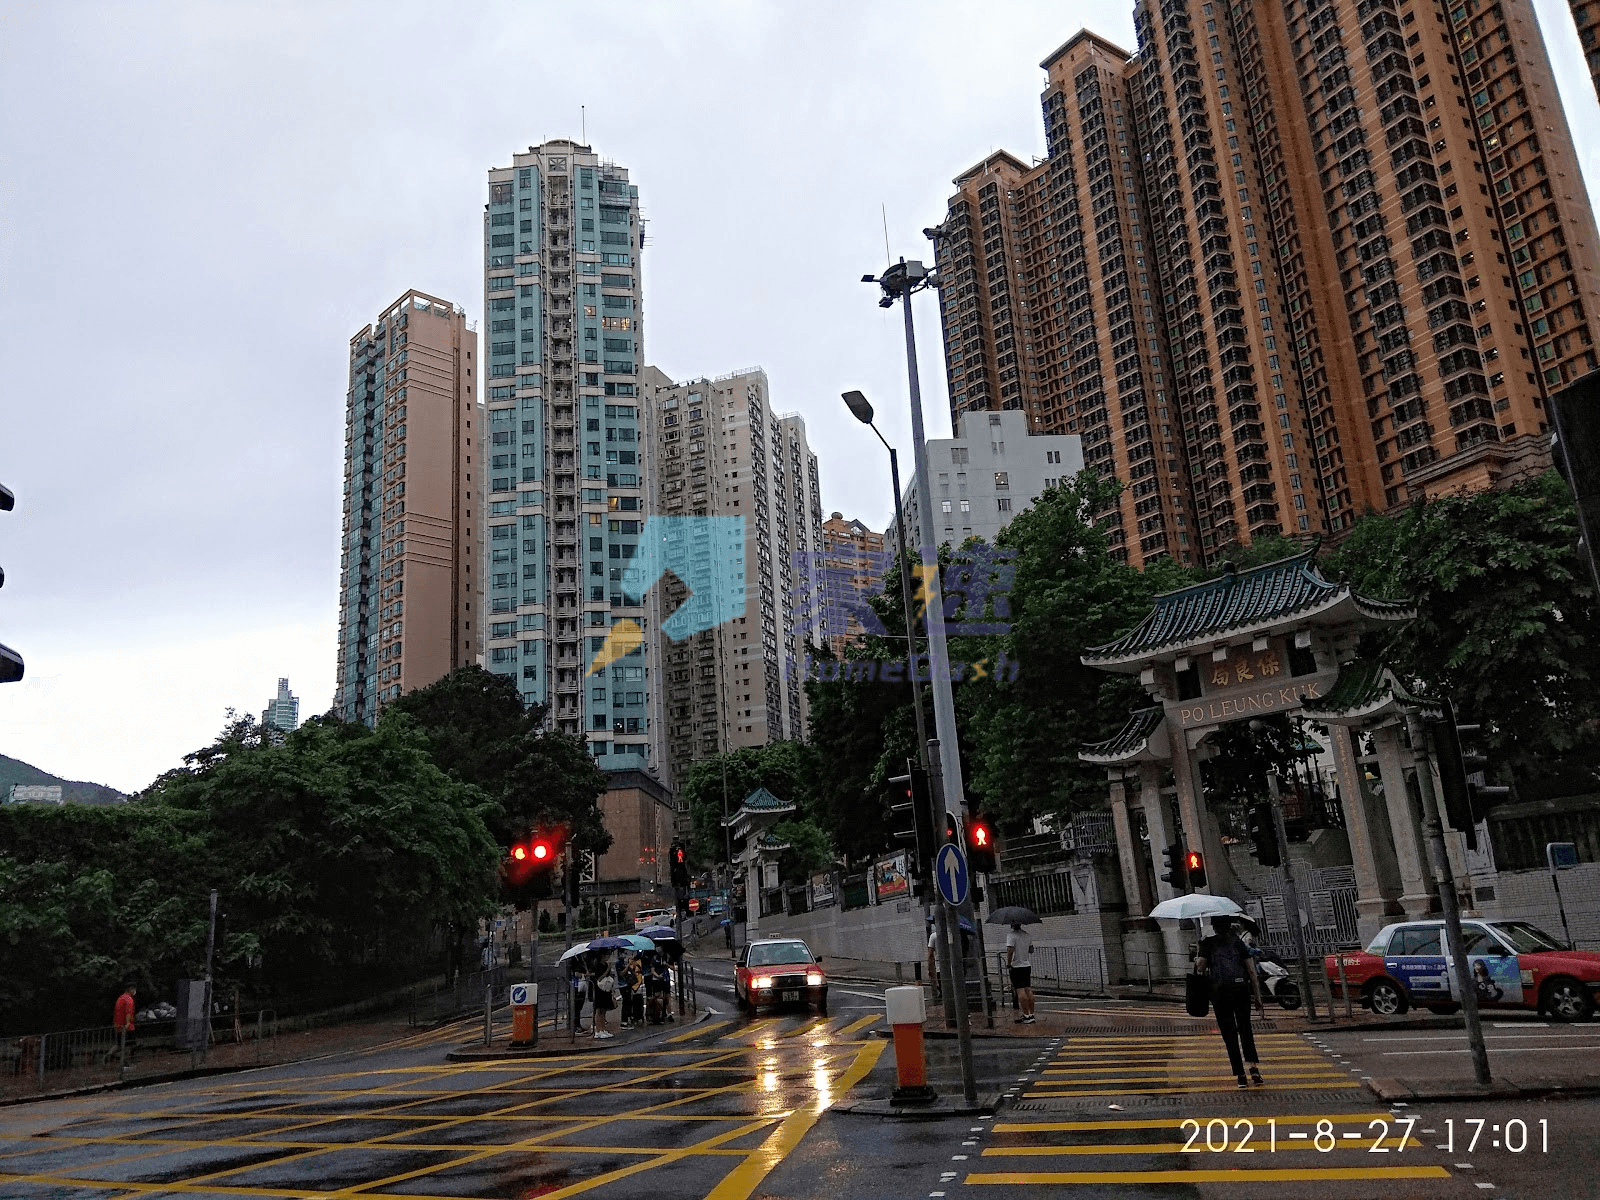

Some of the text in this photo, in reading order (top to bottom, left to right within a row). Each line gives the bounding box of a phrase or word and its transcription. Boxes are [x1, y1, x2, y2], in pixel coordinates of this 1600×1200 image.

[1180, 682, 1322, 725] PO LEUNG KUK
